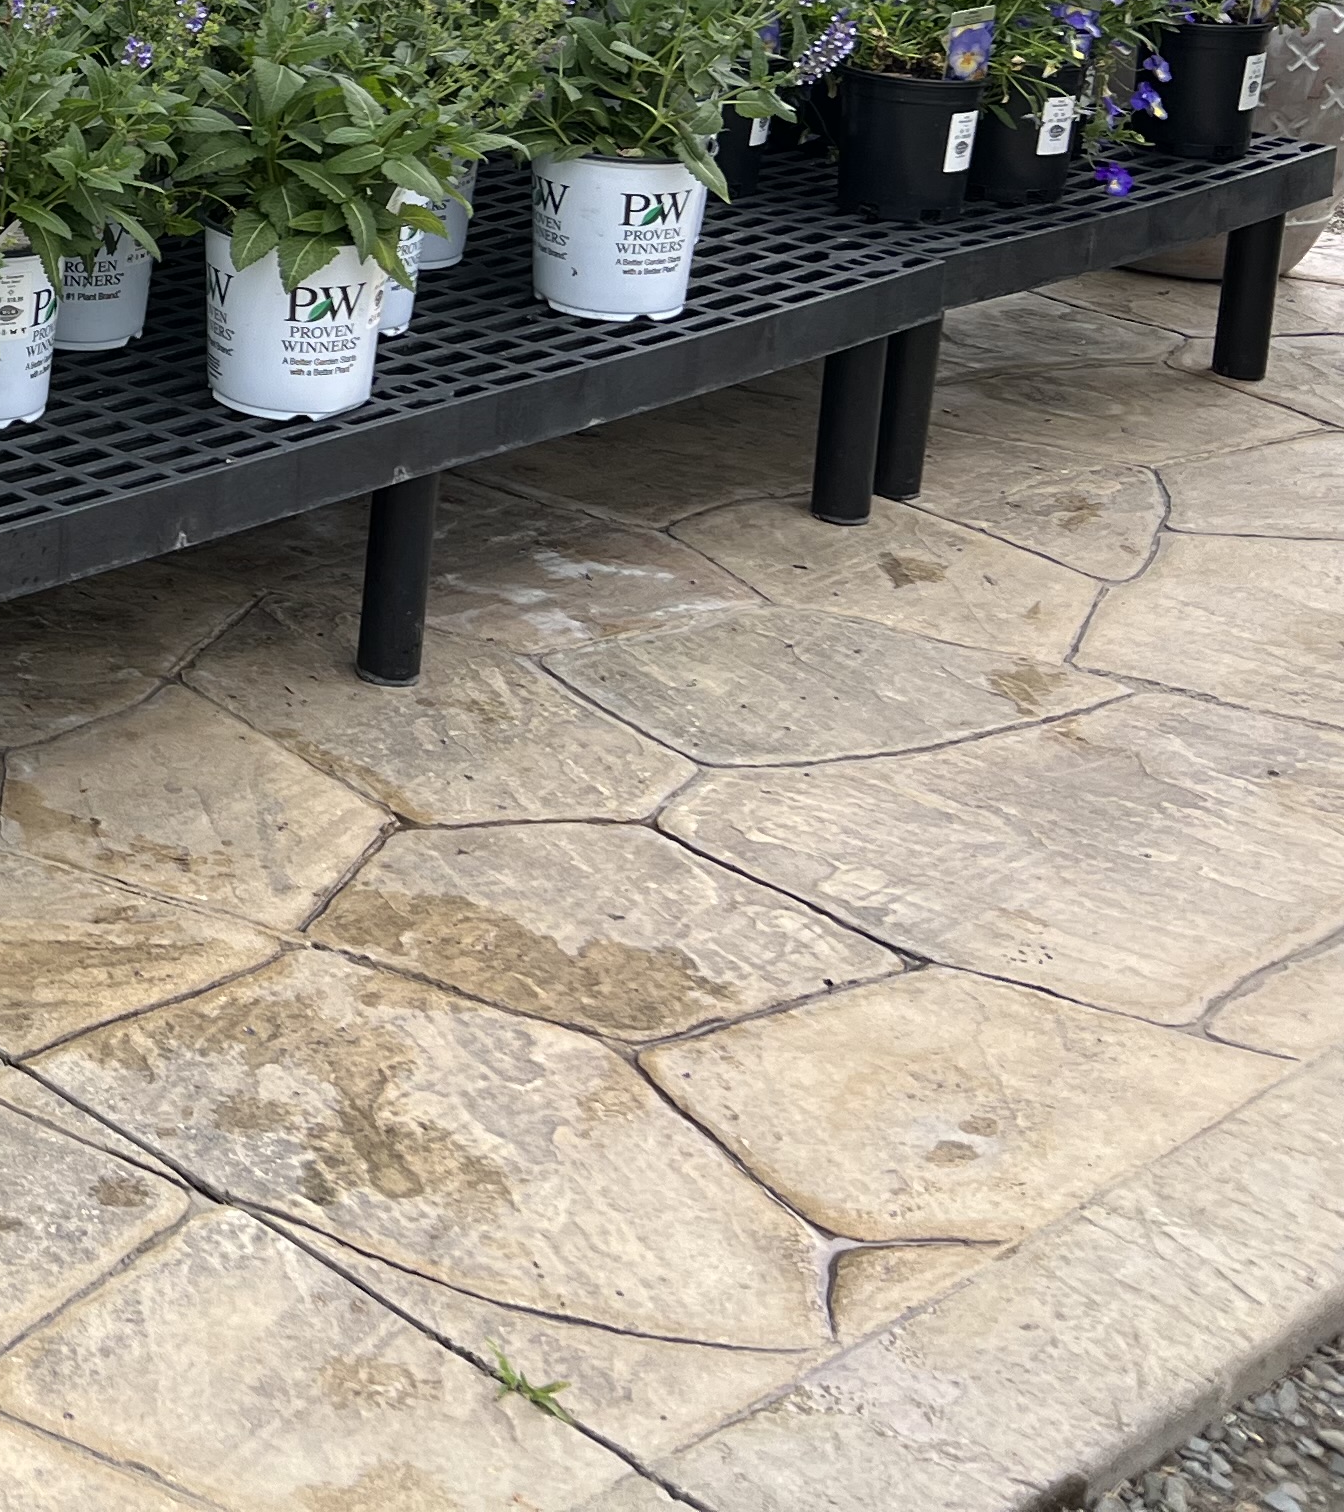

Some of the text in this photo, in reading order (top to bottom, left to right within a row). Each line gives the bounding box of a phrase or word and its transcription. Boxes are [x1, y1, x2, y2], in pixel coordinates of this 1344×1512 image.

[618, 189, 692, 227] PW
[624, 227, 681, 241] PROVEN
[284, 282, 366, 322] PW
[290, 325, 355, 339] PROVEN
